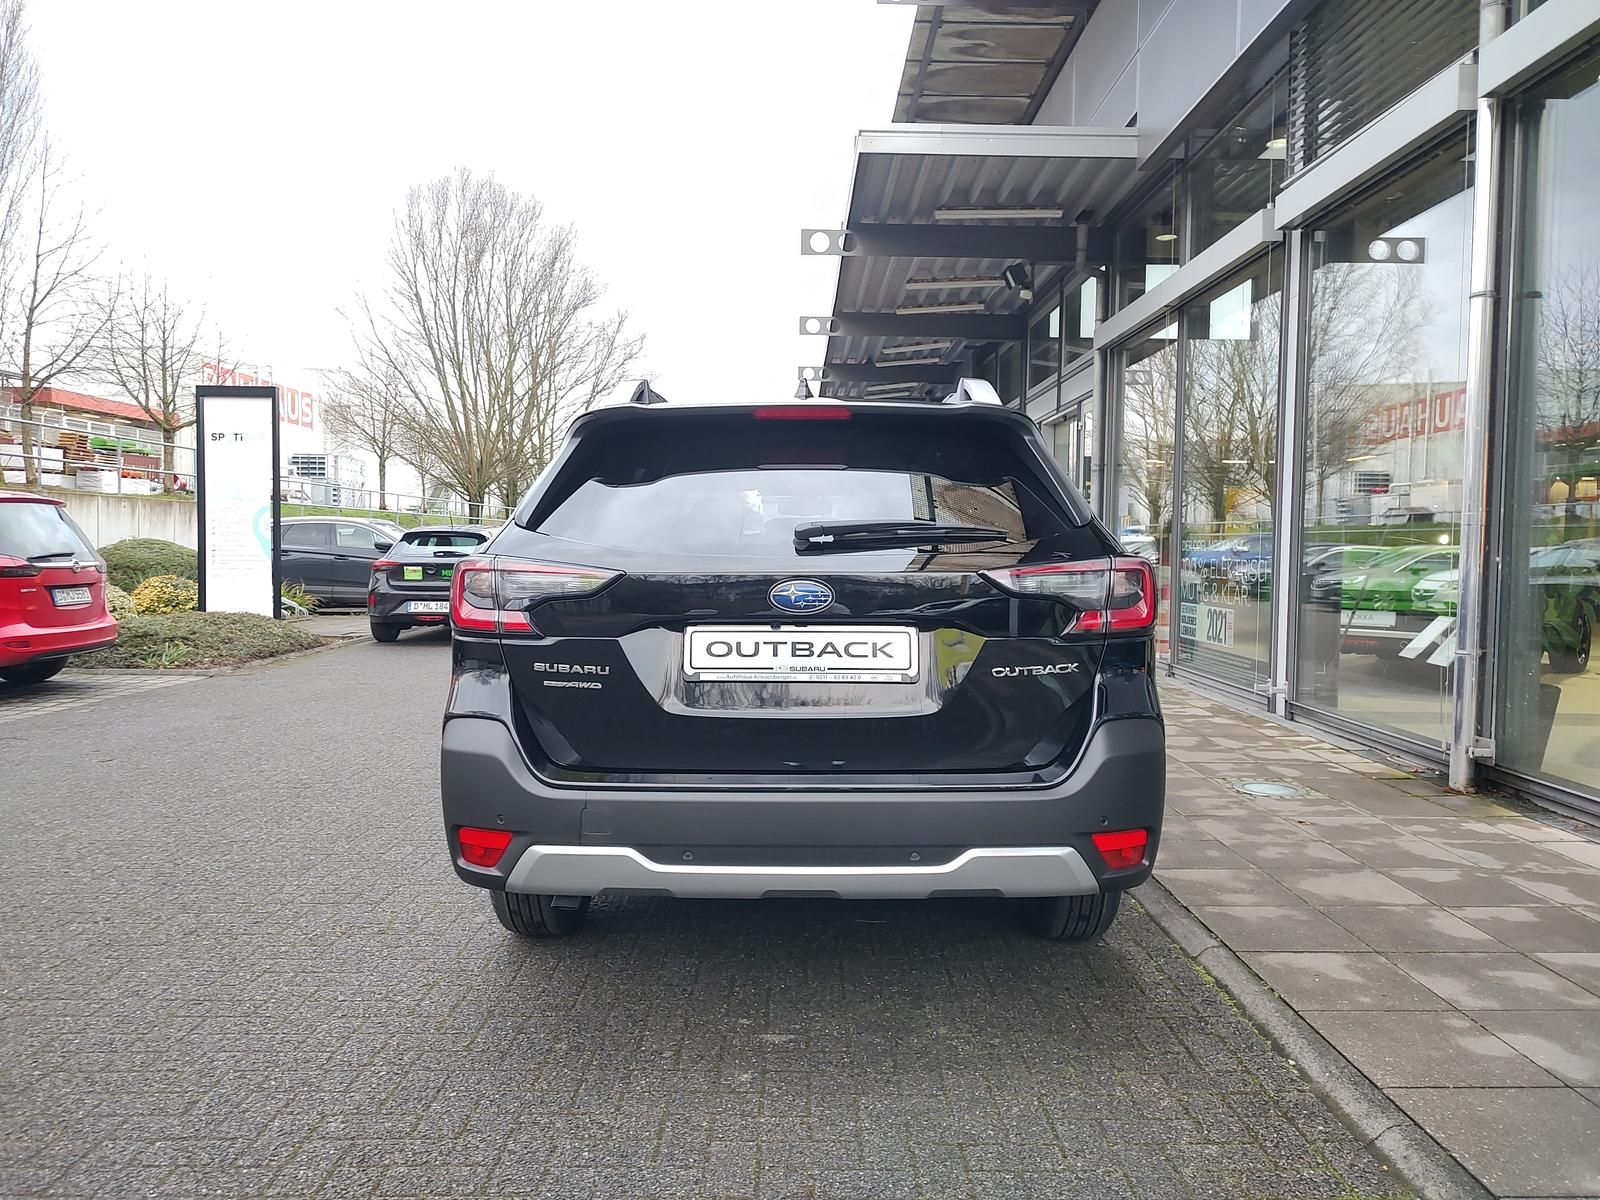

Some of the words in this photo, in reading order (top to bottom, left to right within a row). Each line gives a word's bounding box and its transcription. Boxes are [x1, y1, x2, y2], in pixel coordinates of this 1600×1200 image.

[1207, 608, 1227, 645] 2021
[706, 640, 894, 658] OUTBACK
[533, 662, 610, 675] SUBARU
[991, 662, 1079, 677] OUTBACK
